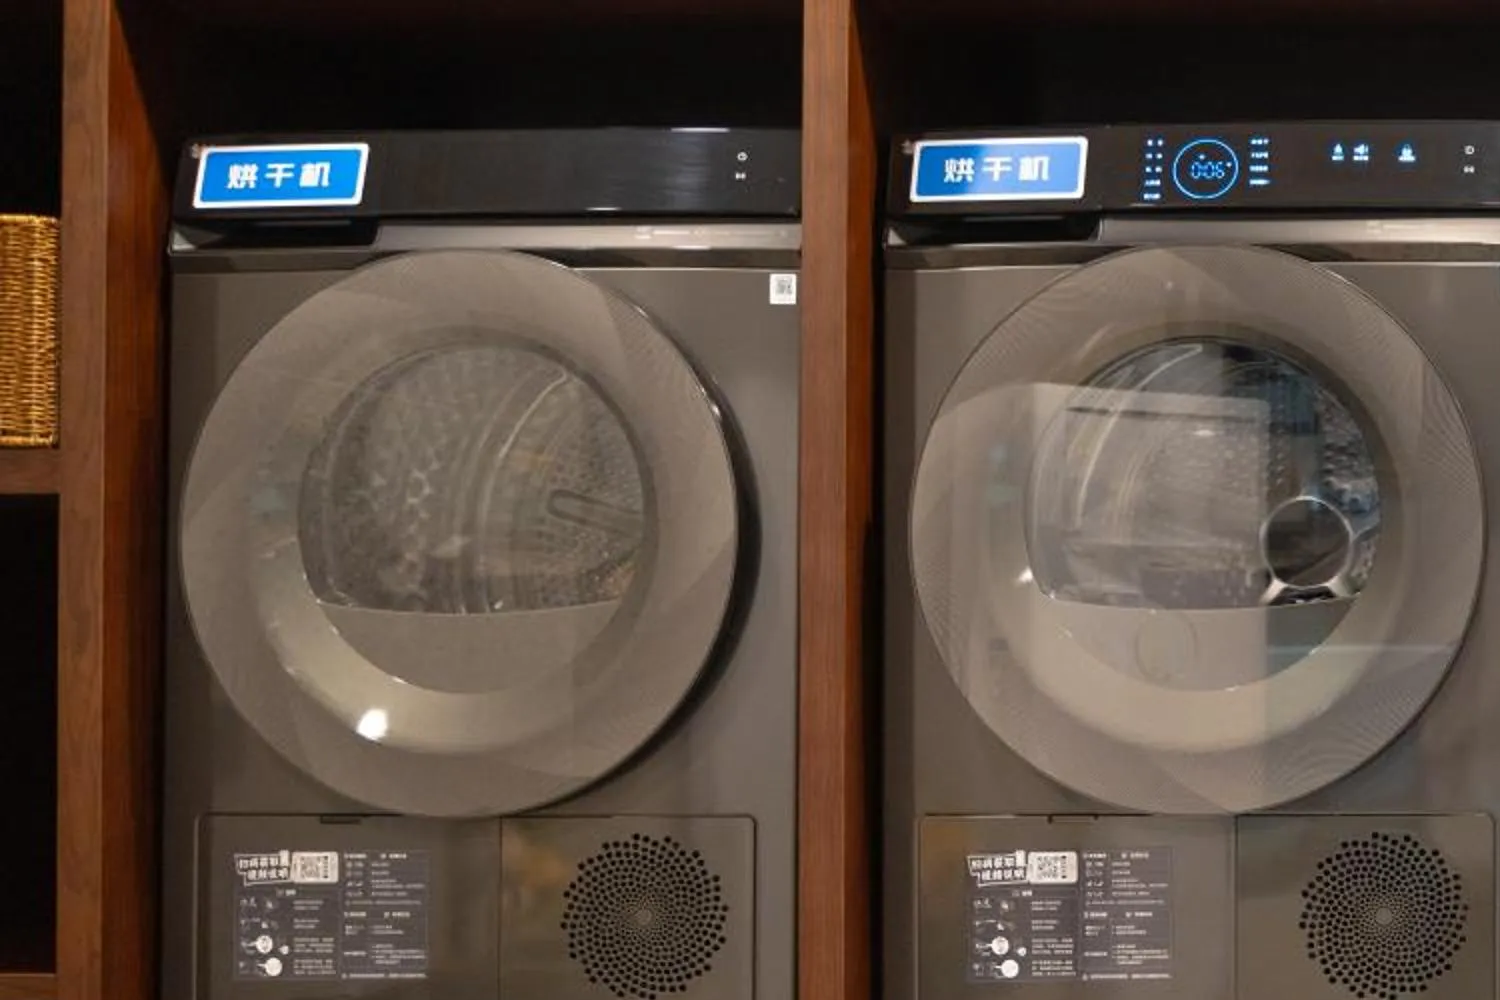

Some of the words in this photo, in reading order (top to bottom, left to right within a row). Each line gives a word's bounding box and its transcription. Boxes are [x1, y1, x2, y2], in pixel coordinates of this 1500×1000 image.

[227, 161, 330, 189] 烘干机
[944, 156, 1050, 183] 烘干机
